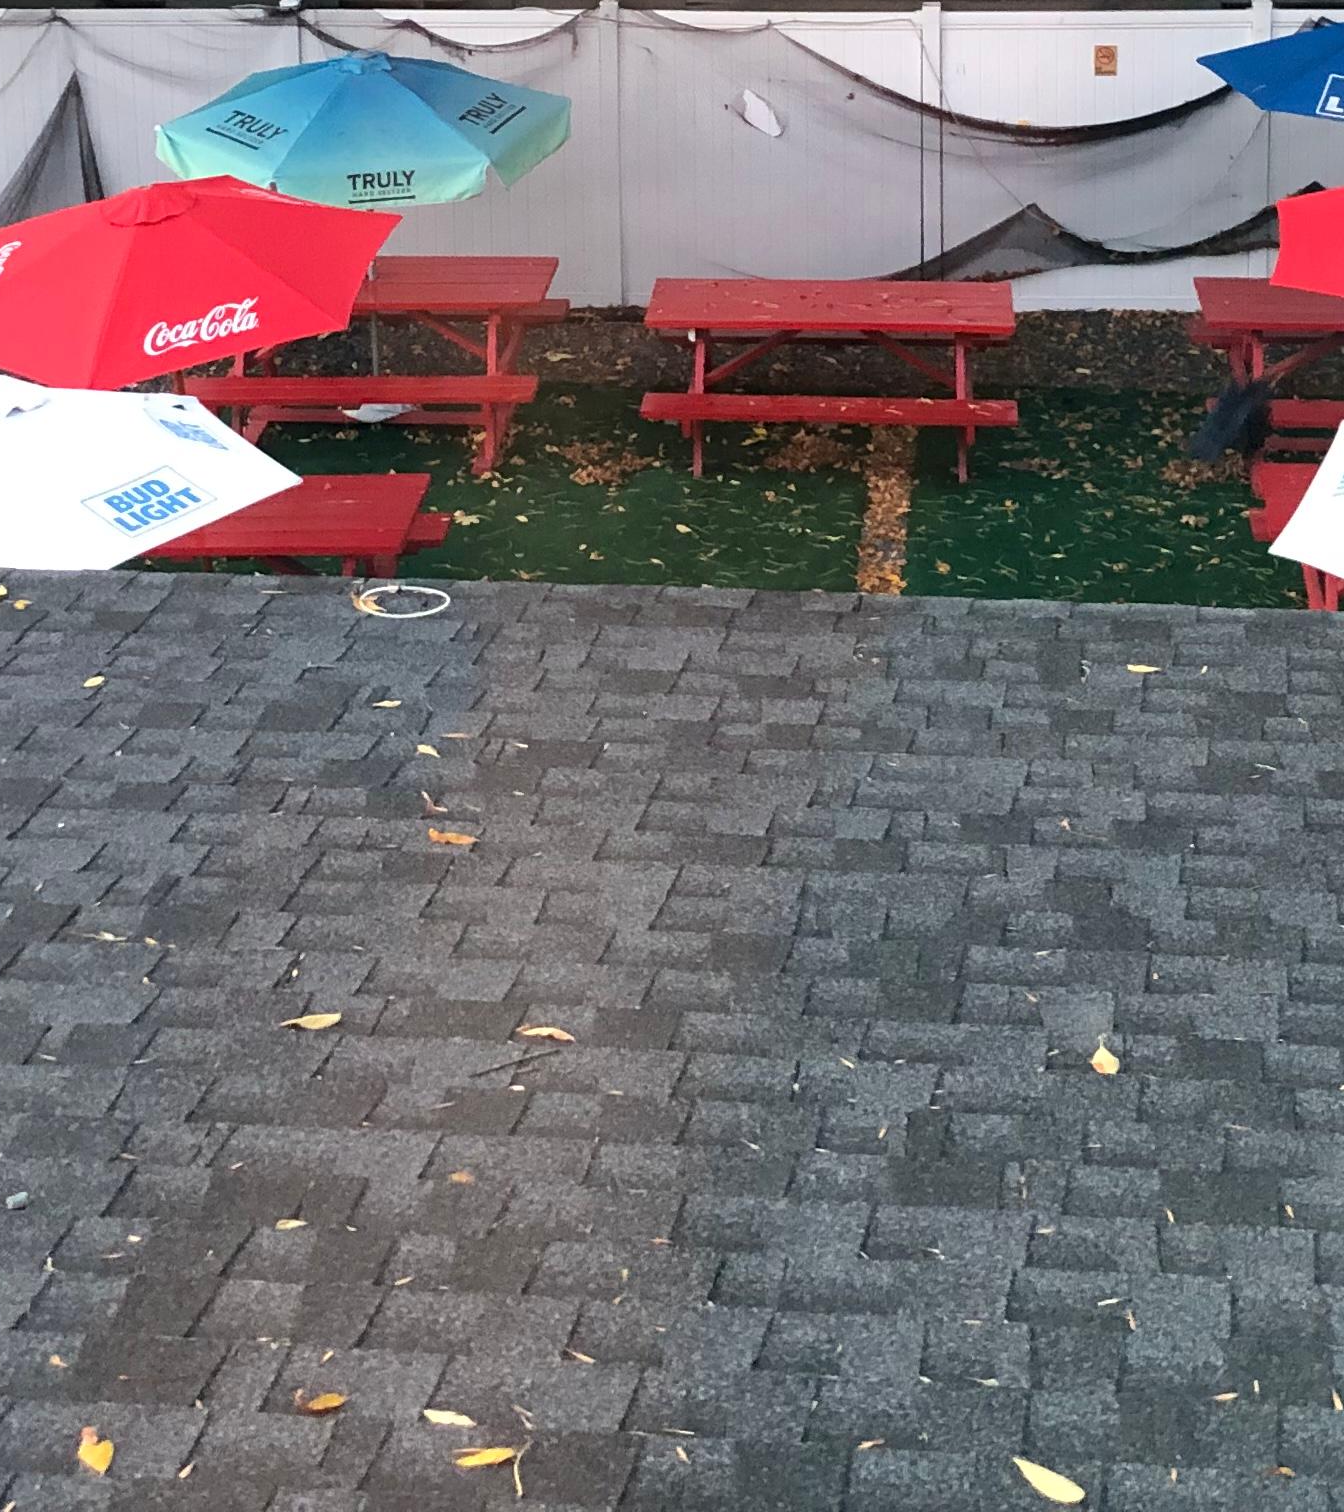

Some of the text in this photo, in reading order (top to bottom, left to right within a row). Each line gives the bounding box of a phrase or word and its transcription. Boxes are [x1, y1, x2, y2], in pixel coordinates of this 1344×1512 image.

[223, 110, 288, 140] TRULY
[458, 92, 508, 125] TRULY
[347, 169, 416, 190] TRULY
[143, 295, 260, 356] Coca-Cola
[103, 479, 171, 513] BUD
[113, 487, 202, 532] LIGHT
